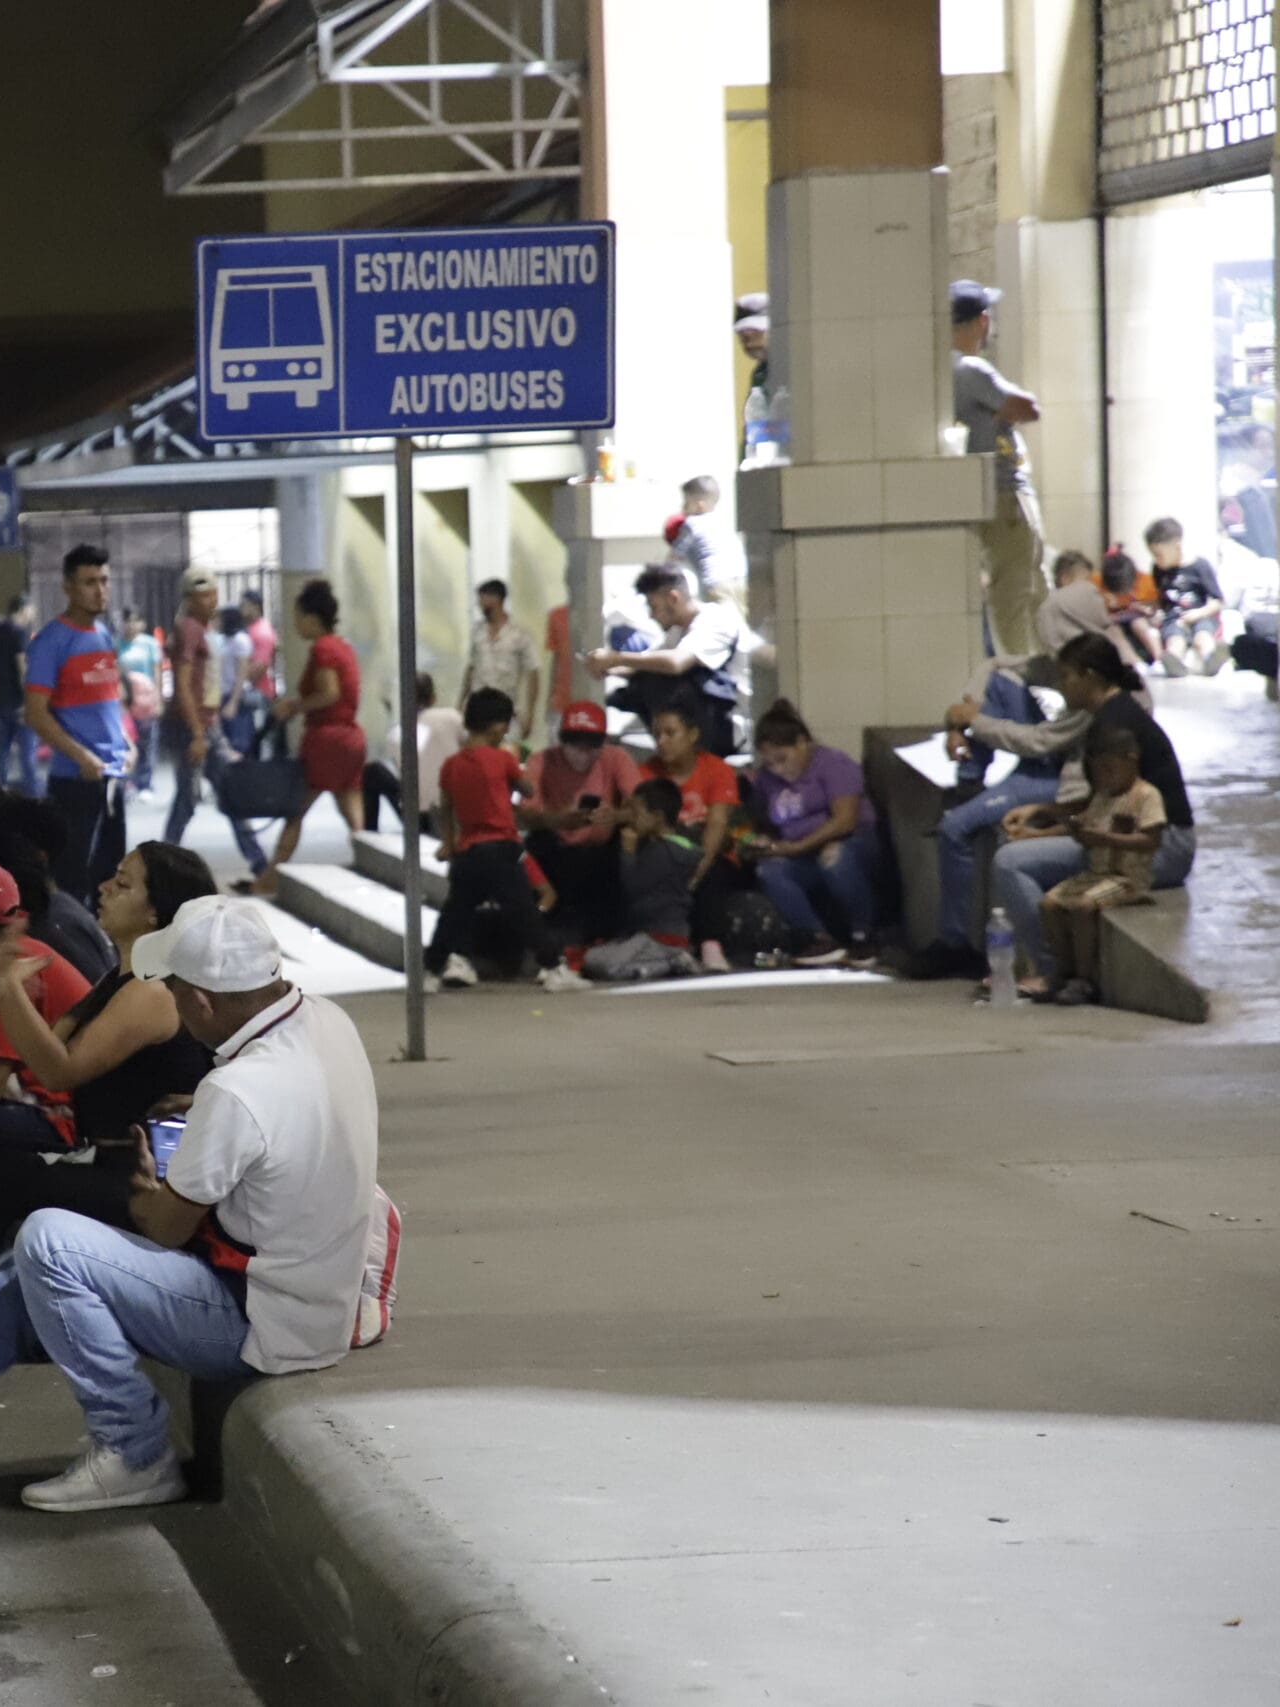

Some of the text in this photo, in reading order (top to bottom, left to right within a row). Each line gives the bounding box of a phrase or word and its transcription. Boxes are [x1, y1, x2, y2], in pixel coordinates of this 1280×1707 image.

[354, 244, 599, 293] ESTACIONAMIENTO
[375, 307, 577, 354] EXCLUSIVO
[389, 369, 565, 415] AUTOBUSES
